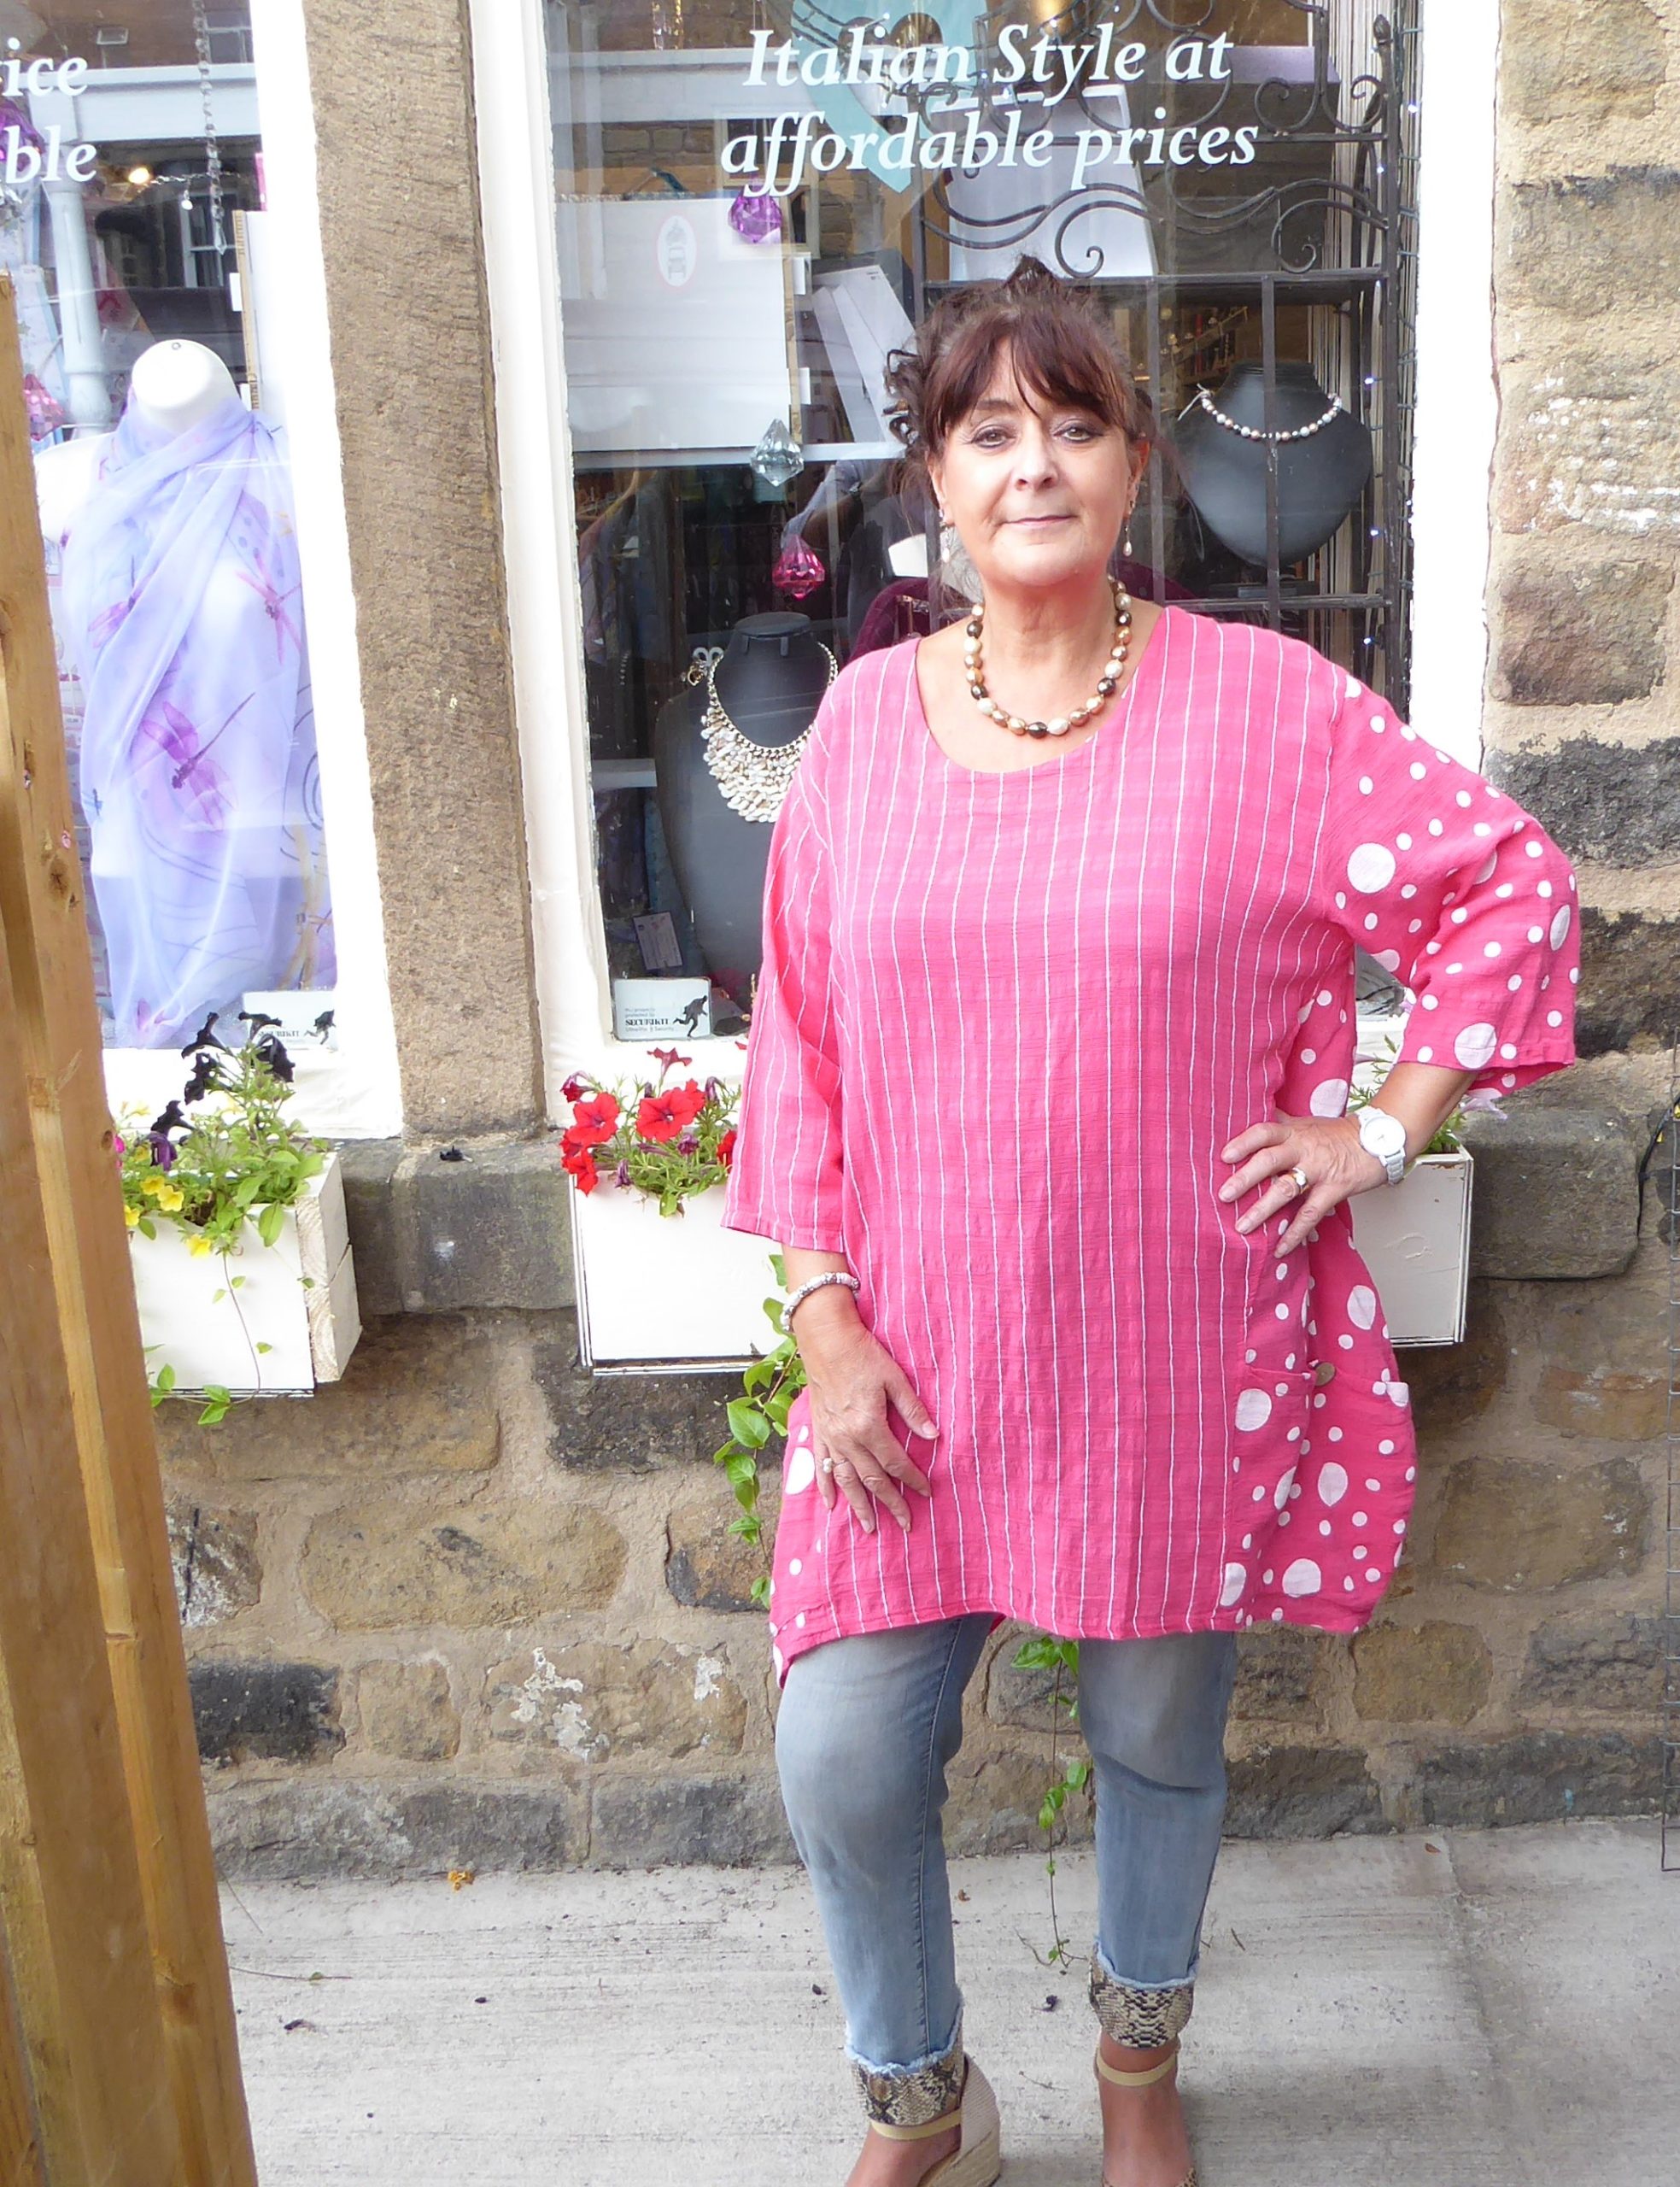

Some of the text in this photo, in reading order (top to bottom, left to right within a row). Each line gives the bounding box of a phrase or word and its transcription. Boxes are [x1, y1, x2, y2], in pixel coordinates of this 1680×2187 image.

[0, 37, 89, 97] ice
[742, 22, 1235, 107] Italian Style at
[0, 124, 97, 184] ble
[720, 107, 1260, 197] affordable prices
